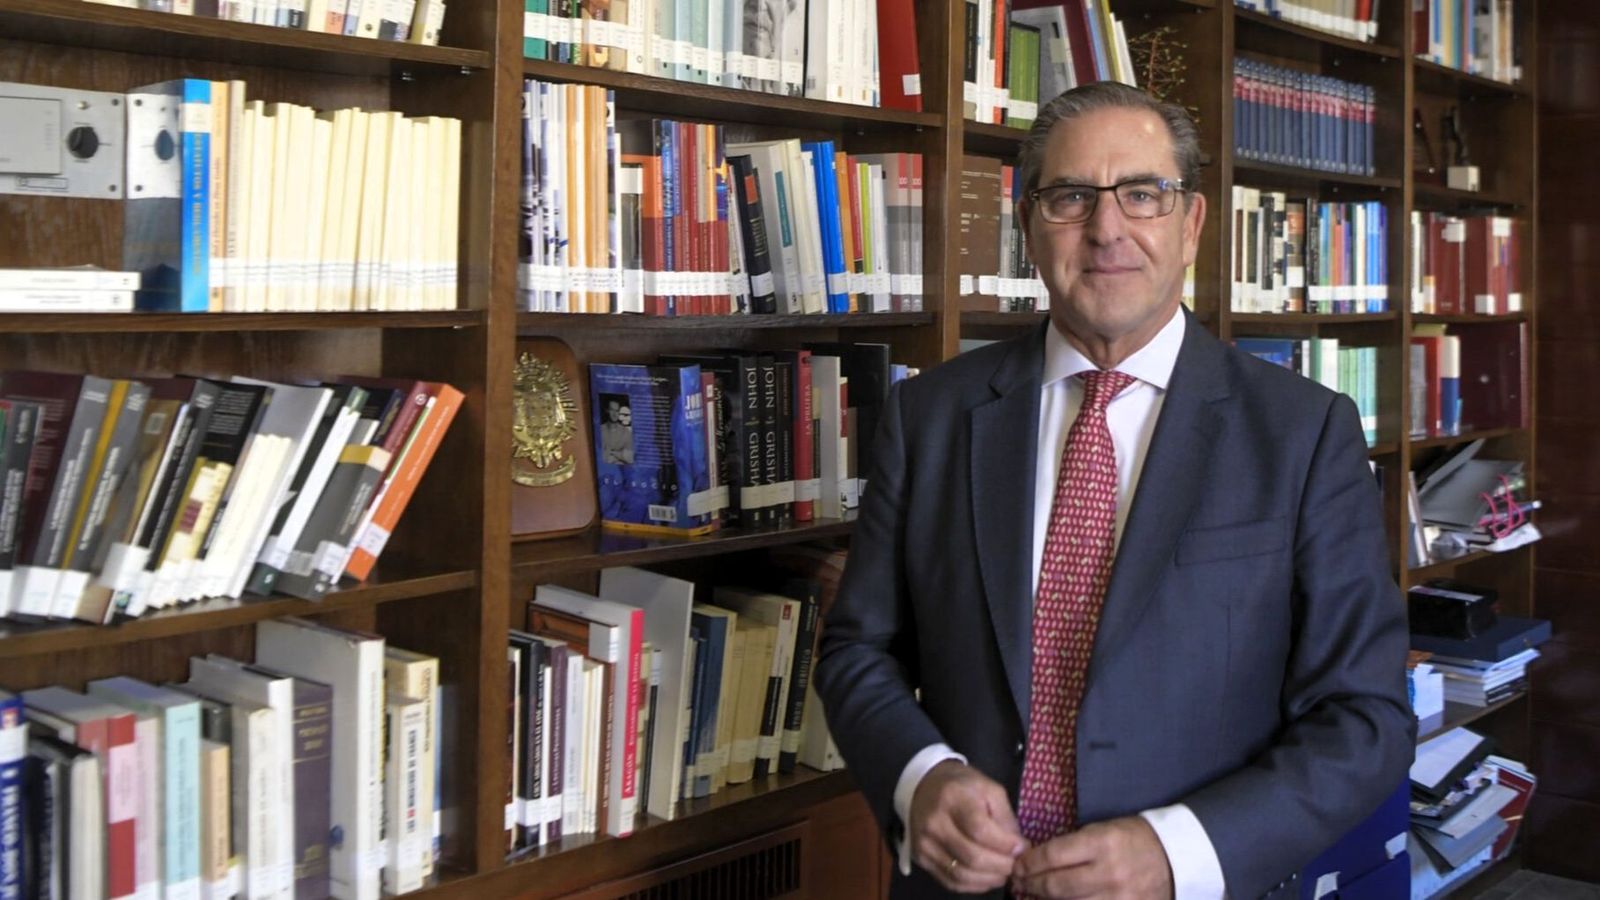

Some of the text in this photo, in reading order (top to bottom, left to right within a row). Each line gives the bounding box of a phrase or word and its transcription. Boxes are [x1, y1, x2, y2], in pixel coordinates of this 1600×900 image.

[744, 366, 760, 486] JOHN GRISHA
[762, 365, 776, 484] JOHN GRISHA
